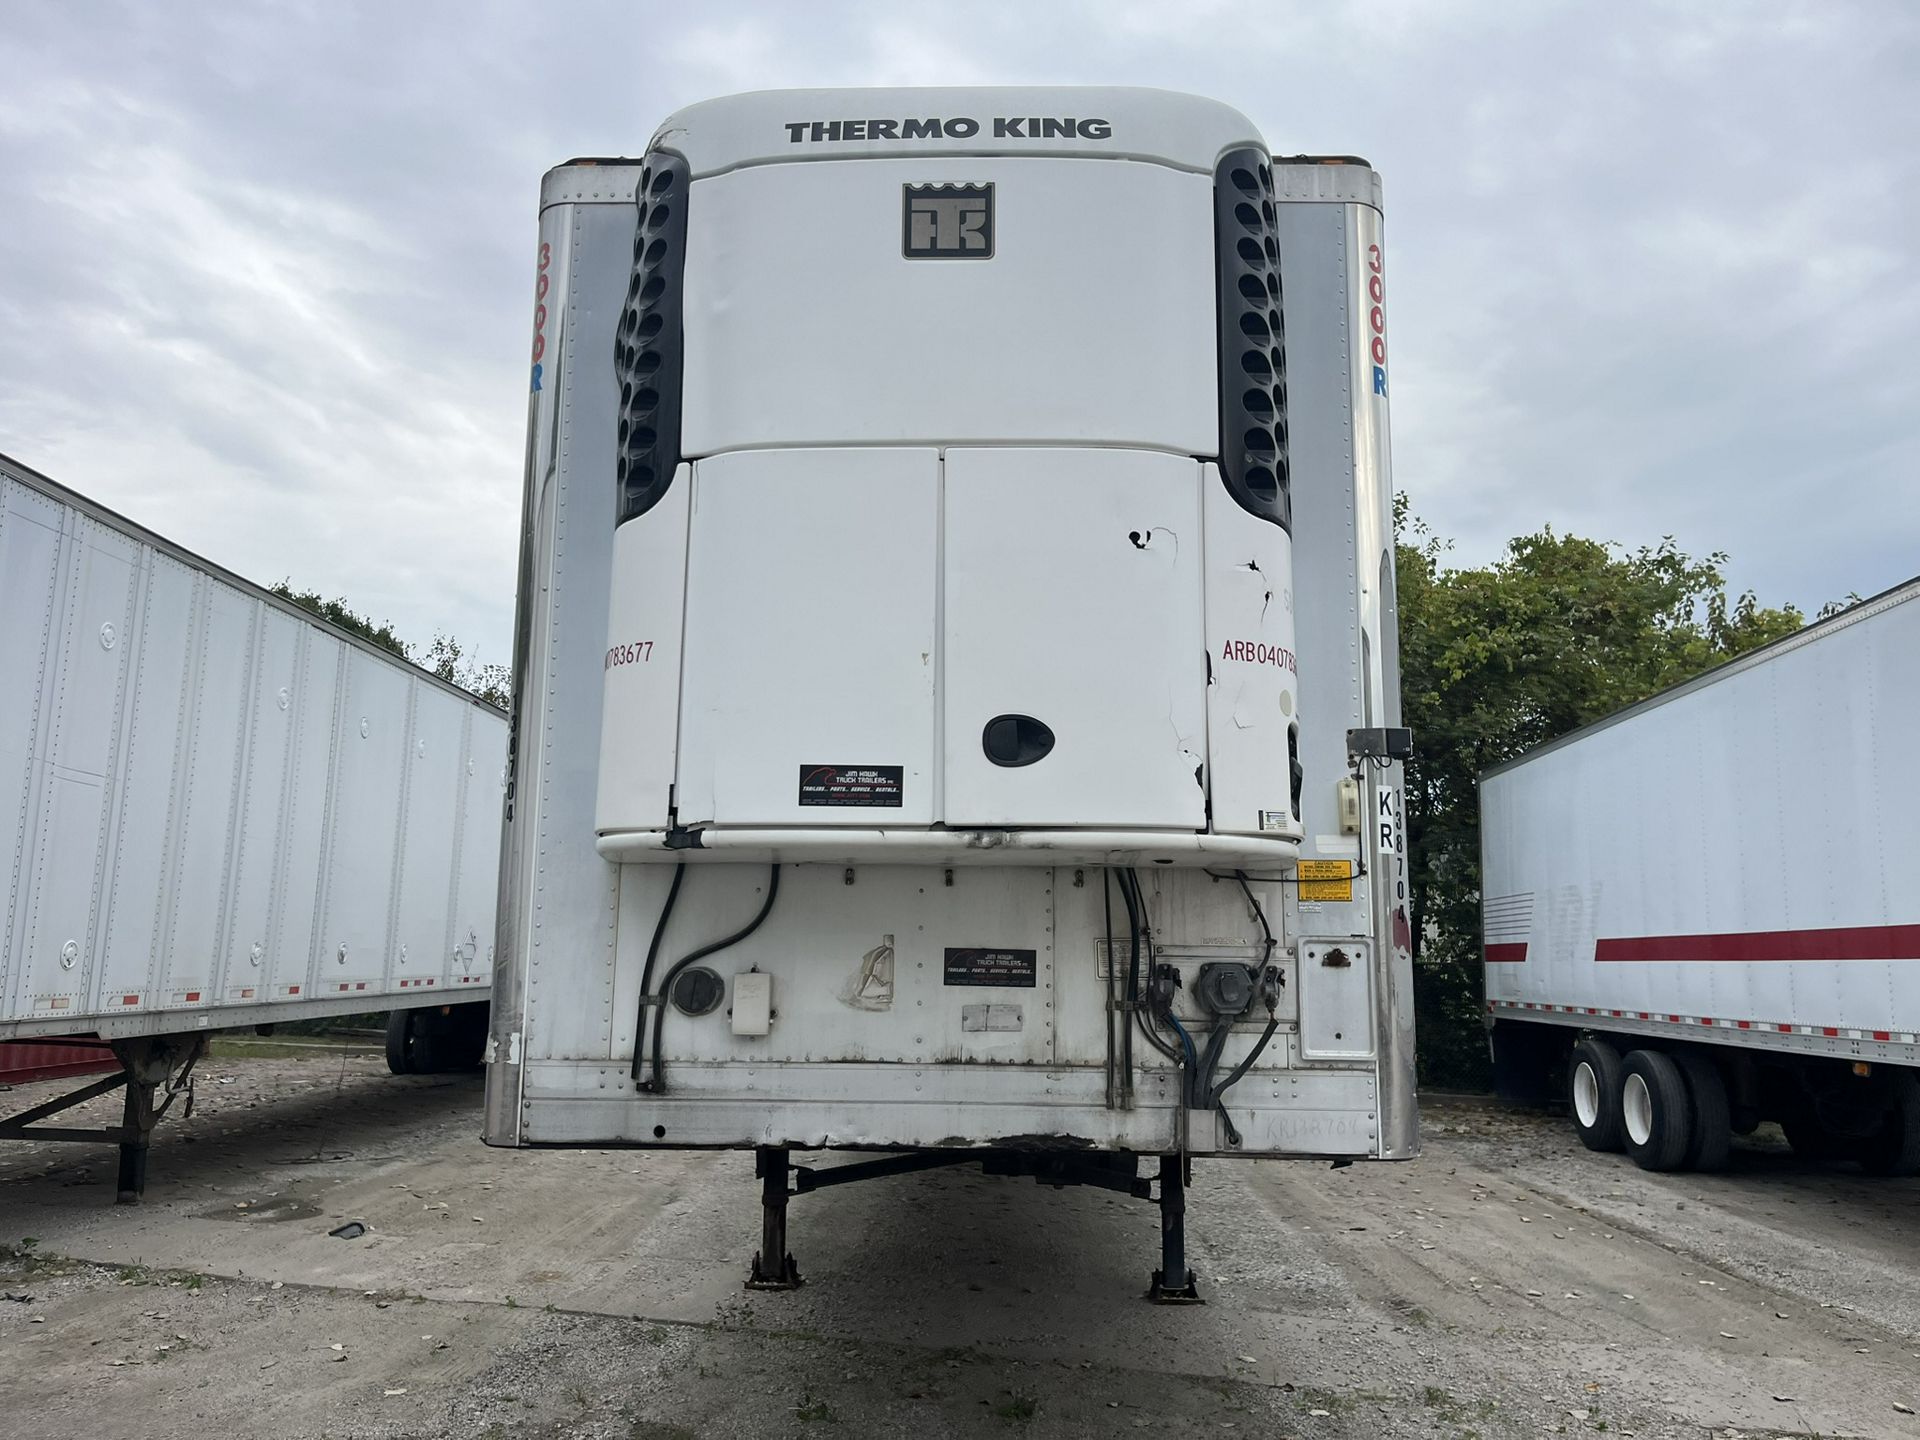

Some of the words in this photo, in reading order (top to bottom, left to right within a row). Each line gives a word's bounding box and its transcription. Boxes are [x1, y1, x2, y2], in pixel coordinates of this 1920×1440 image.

[785, 117, 980, 143] THERMO
[993, 117, 1112, 139] KING
[531, 242, 551, 392] 3000R
[1368, 244, 1388, 398] 3000R
[1395, 788, 1405, 923] 138704
